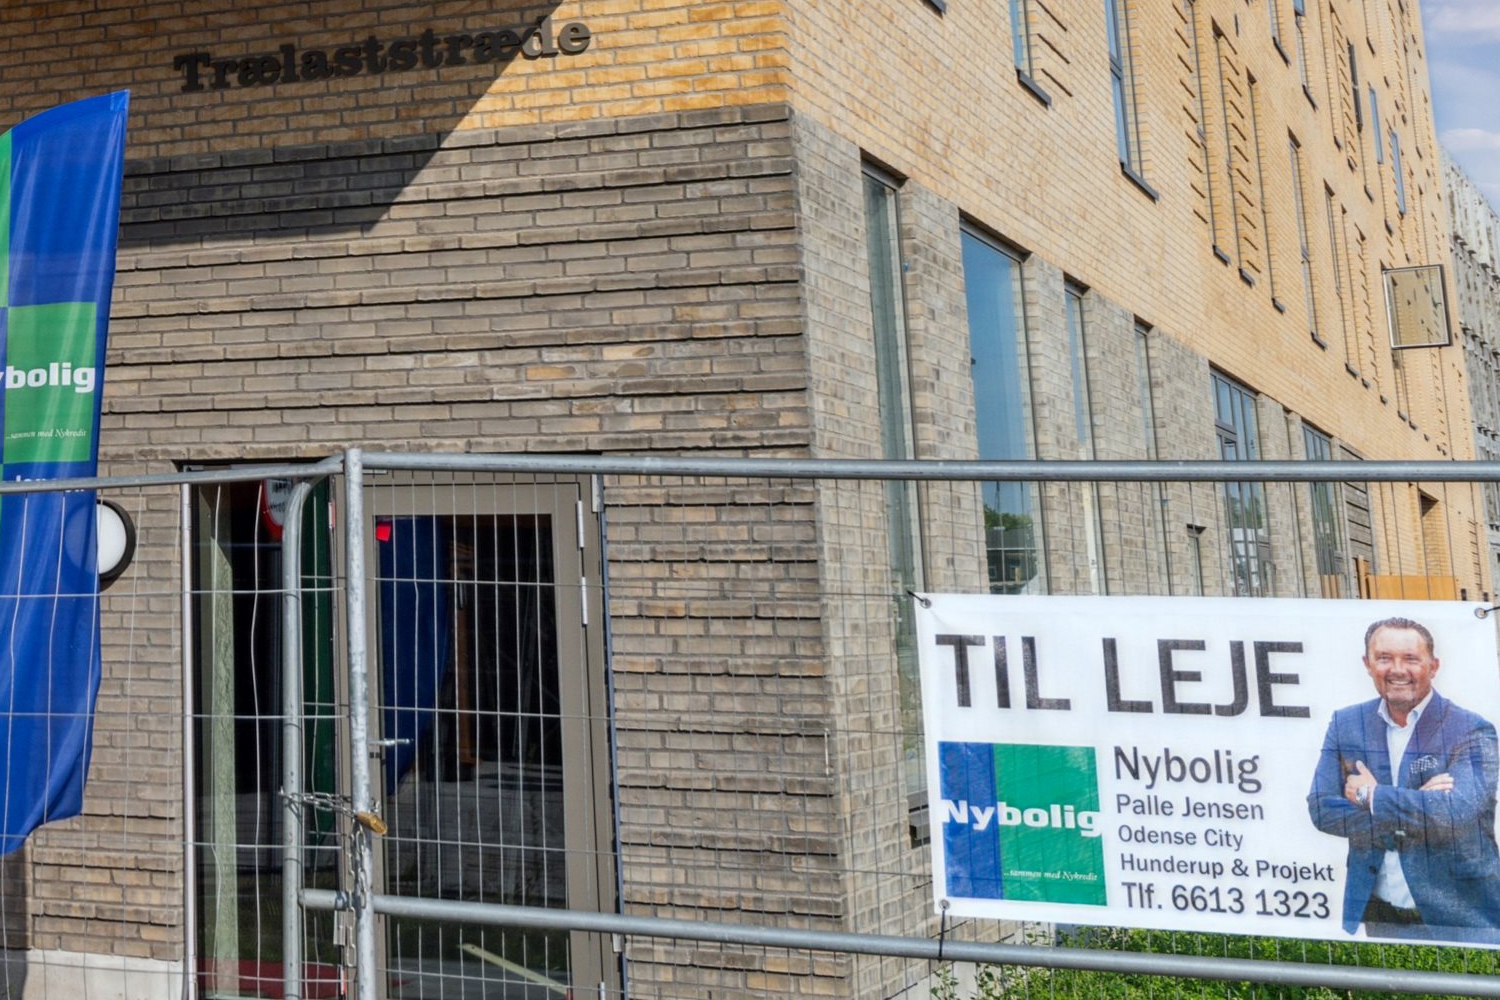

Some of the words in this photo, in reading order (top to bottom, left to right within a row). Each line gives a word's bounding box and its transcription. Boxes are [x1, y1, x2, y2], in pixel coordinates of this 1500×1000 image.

[174, 16, 591, 92] Trælaststræde
[935, 633, 1071, 711] TIL
[1102, 637, 1310, 718] LEJE
[1113, 746, 1262, 794] Nybolig
[939, 799, 1102, 837] Nybolig
[1116, 793, 1174, 816] Palle
[1181, 796, 1264, 820] Jensen
[1118, 824, 1197, 845] Odense
[1204, 828, 1243, 851] City
[1120, 853, 1224, 879] Hunderup
[1231, 858, 1249, 877] &
[1256, 859, 1335, 883] Projekt
[1121, 881, 1162, 909] Tlf.
[1171, 884, 1245, 914] 6613
[1255, 889, 1330, 919] 1323
